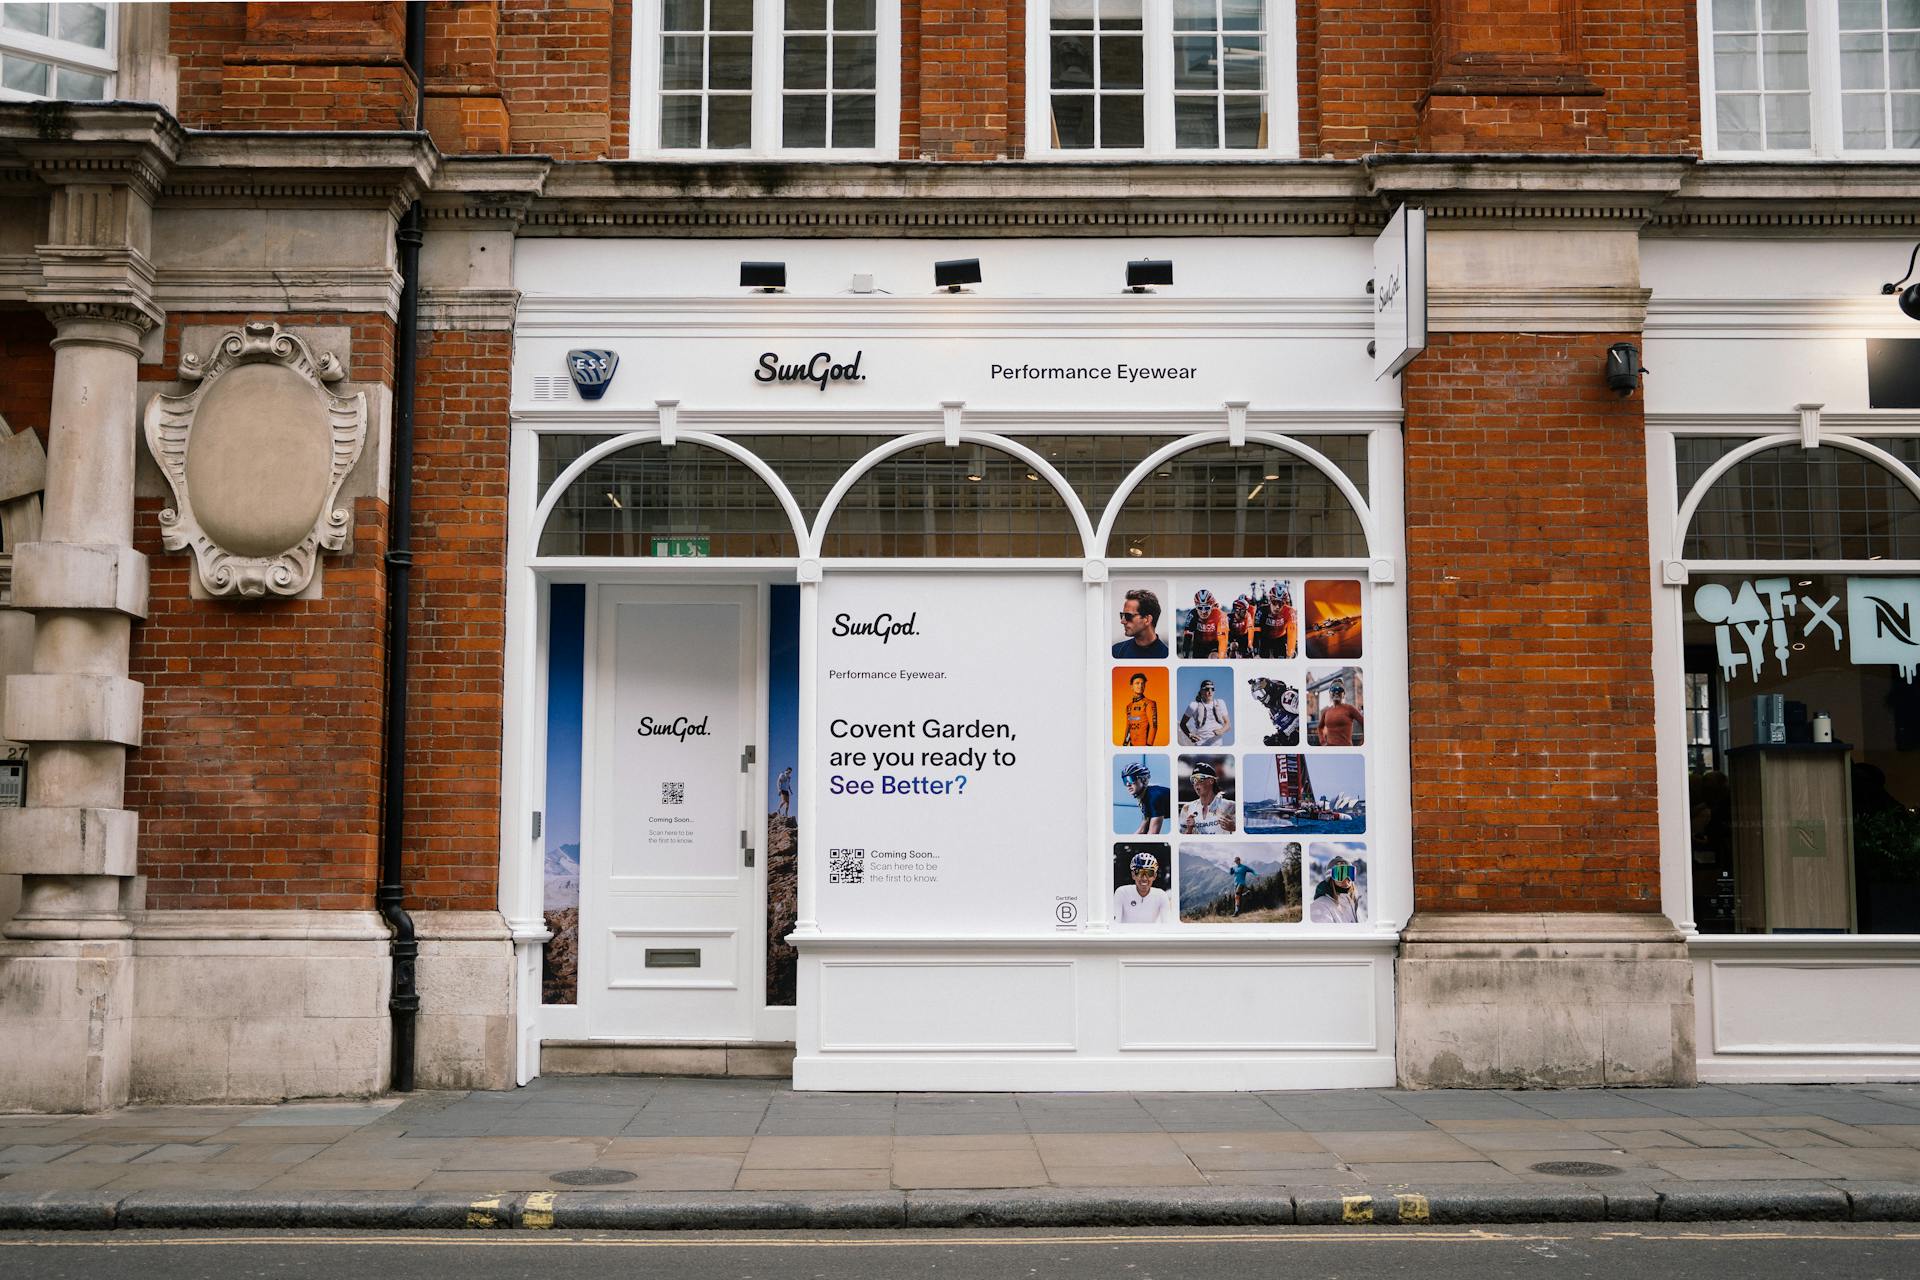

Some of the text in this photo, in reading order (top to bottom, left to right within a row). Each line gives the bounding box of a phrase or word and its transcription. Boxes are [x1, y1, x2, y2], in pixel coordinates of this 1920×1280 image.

[576, 358, 607, 370] ESS
[754, 350, 866, 392] SunGod.
[991, 364, 1198, 383] Performance Eyewear
[831, 612, 921, 645] SunGod.
[829, 669, 947, 681] Performance Eyewear.
[637, 715, 711, 743] SunGod.
[830, 718, 1016, 741] Covent Garden,
[8, 747, 28, 760] 27
[830, 748, 1016, 772] are you ready to
[829, 775, 967, 795] See Better?
[648, 816, 673, 824] Coming
[870, 849, 907, 860] Coming
[870, 862, 938, 871] Scan here to be
[870, 874, 884, 883] the
[885, 874, 901, 883] first
[903, 874, 912, 883] to
